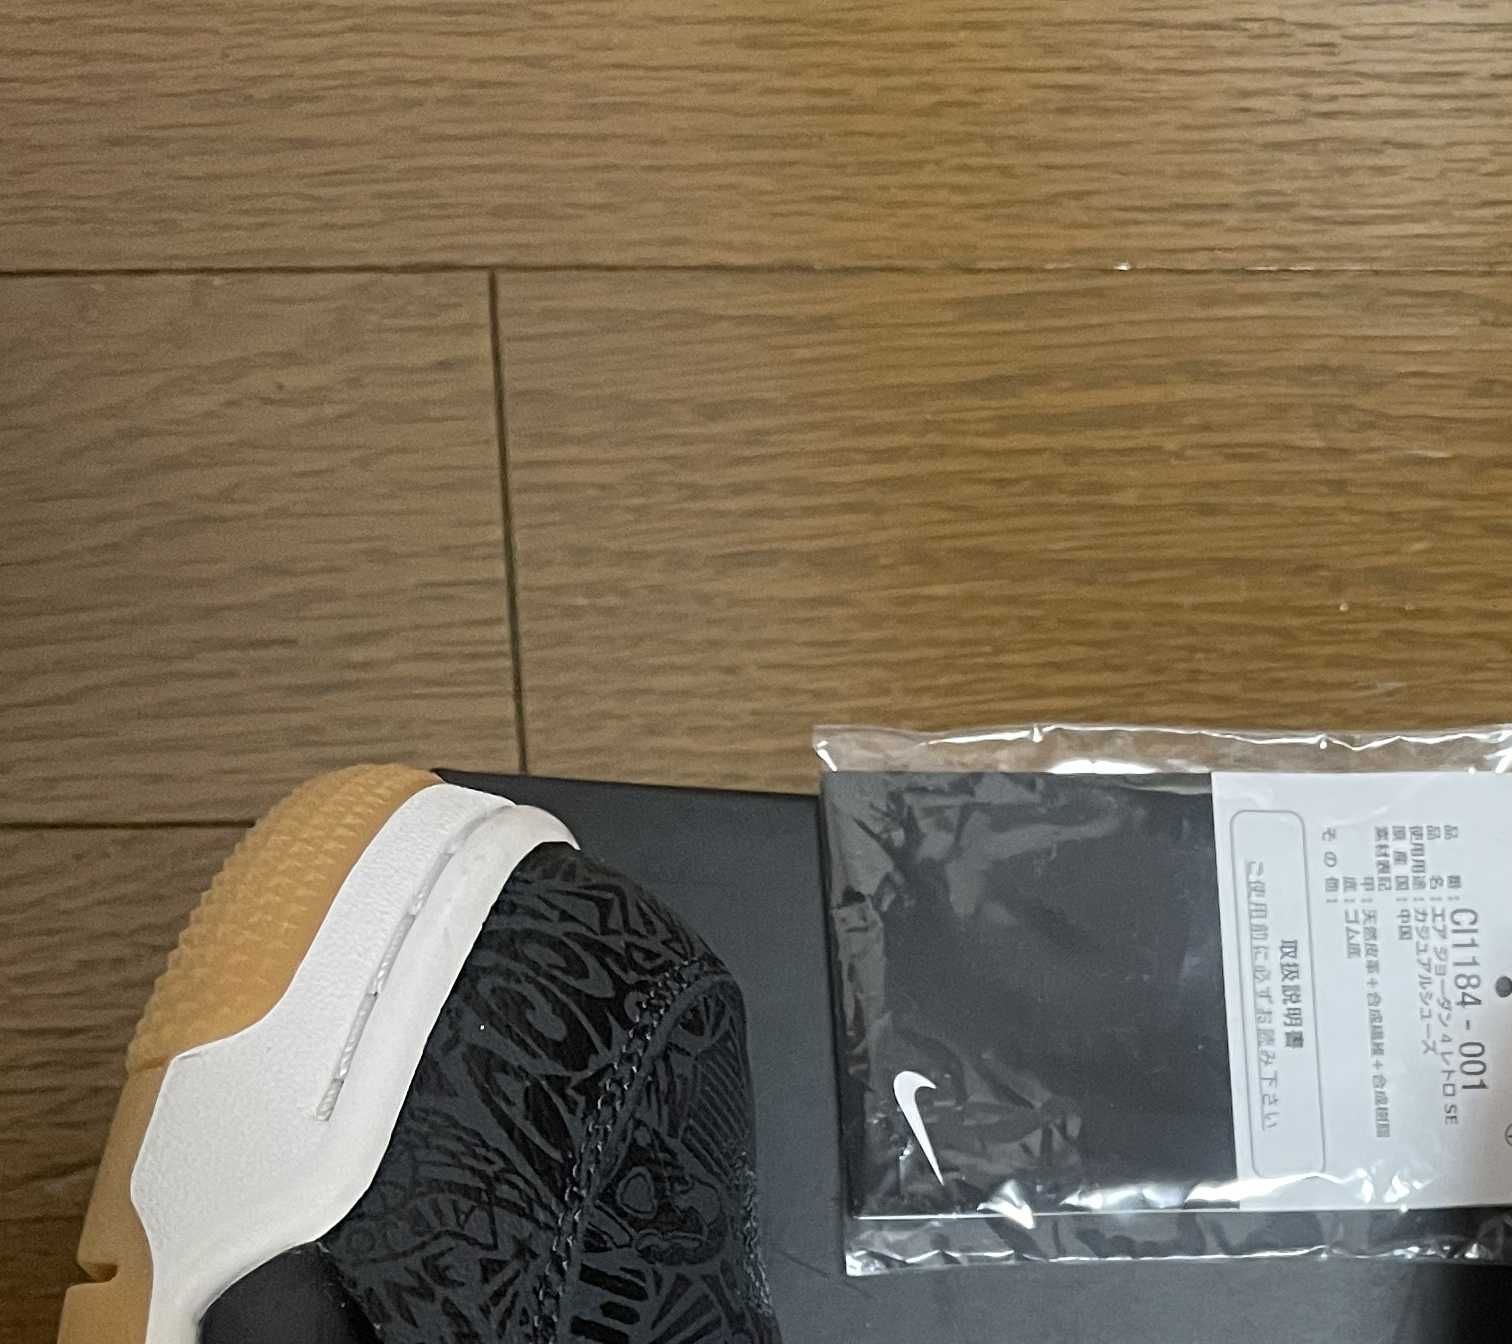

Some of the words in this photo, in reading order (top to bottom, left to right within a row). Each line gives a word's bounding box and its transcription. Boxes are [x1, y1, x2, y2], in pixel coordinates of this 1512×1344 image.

[1279, 938, 1305, 1049] 取扱説明書
[1444, 1104, 1459, 1125] SE
